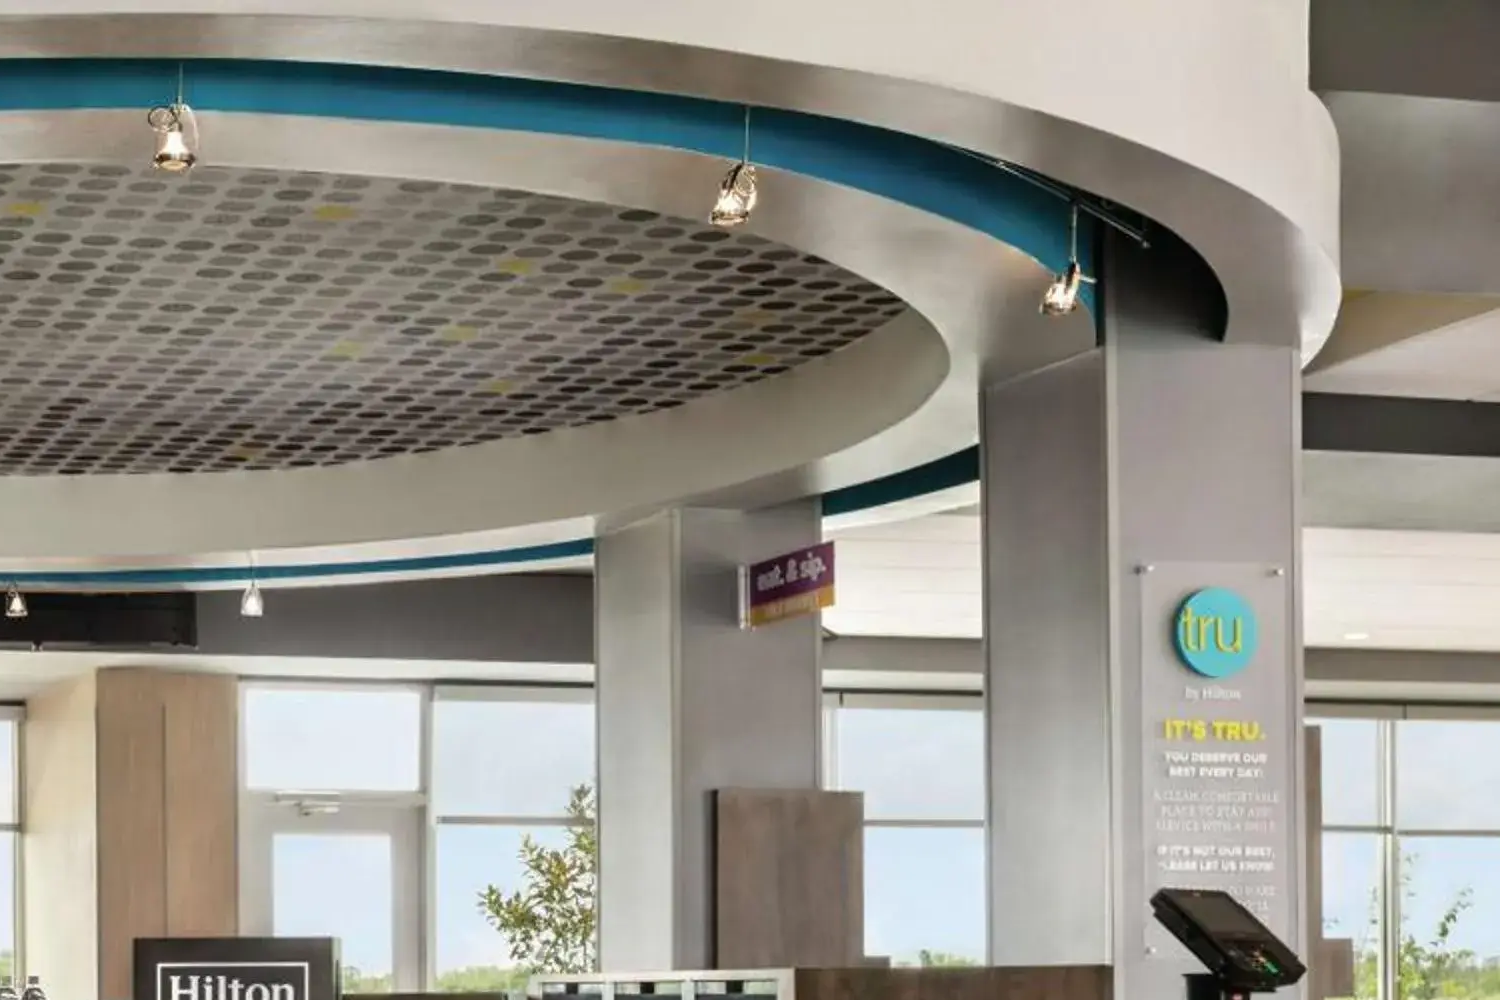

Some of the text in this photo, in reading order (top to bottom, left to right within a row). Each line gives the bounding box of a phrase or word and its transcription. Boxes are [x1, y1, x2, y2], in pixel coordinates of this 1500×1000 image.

[1182, 607, 1243, 653] tru
[1202, 685, 1241, 700] Hilton
[1165, 719, 1267, 741] IT'S TRU.
